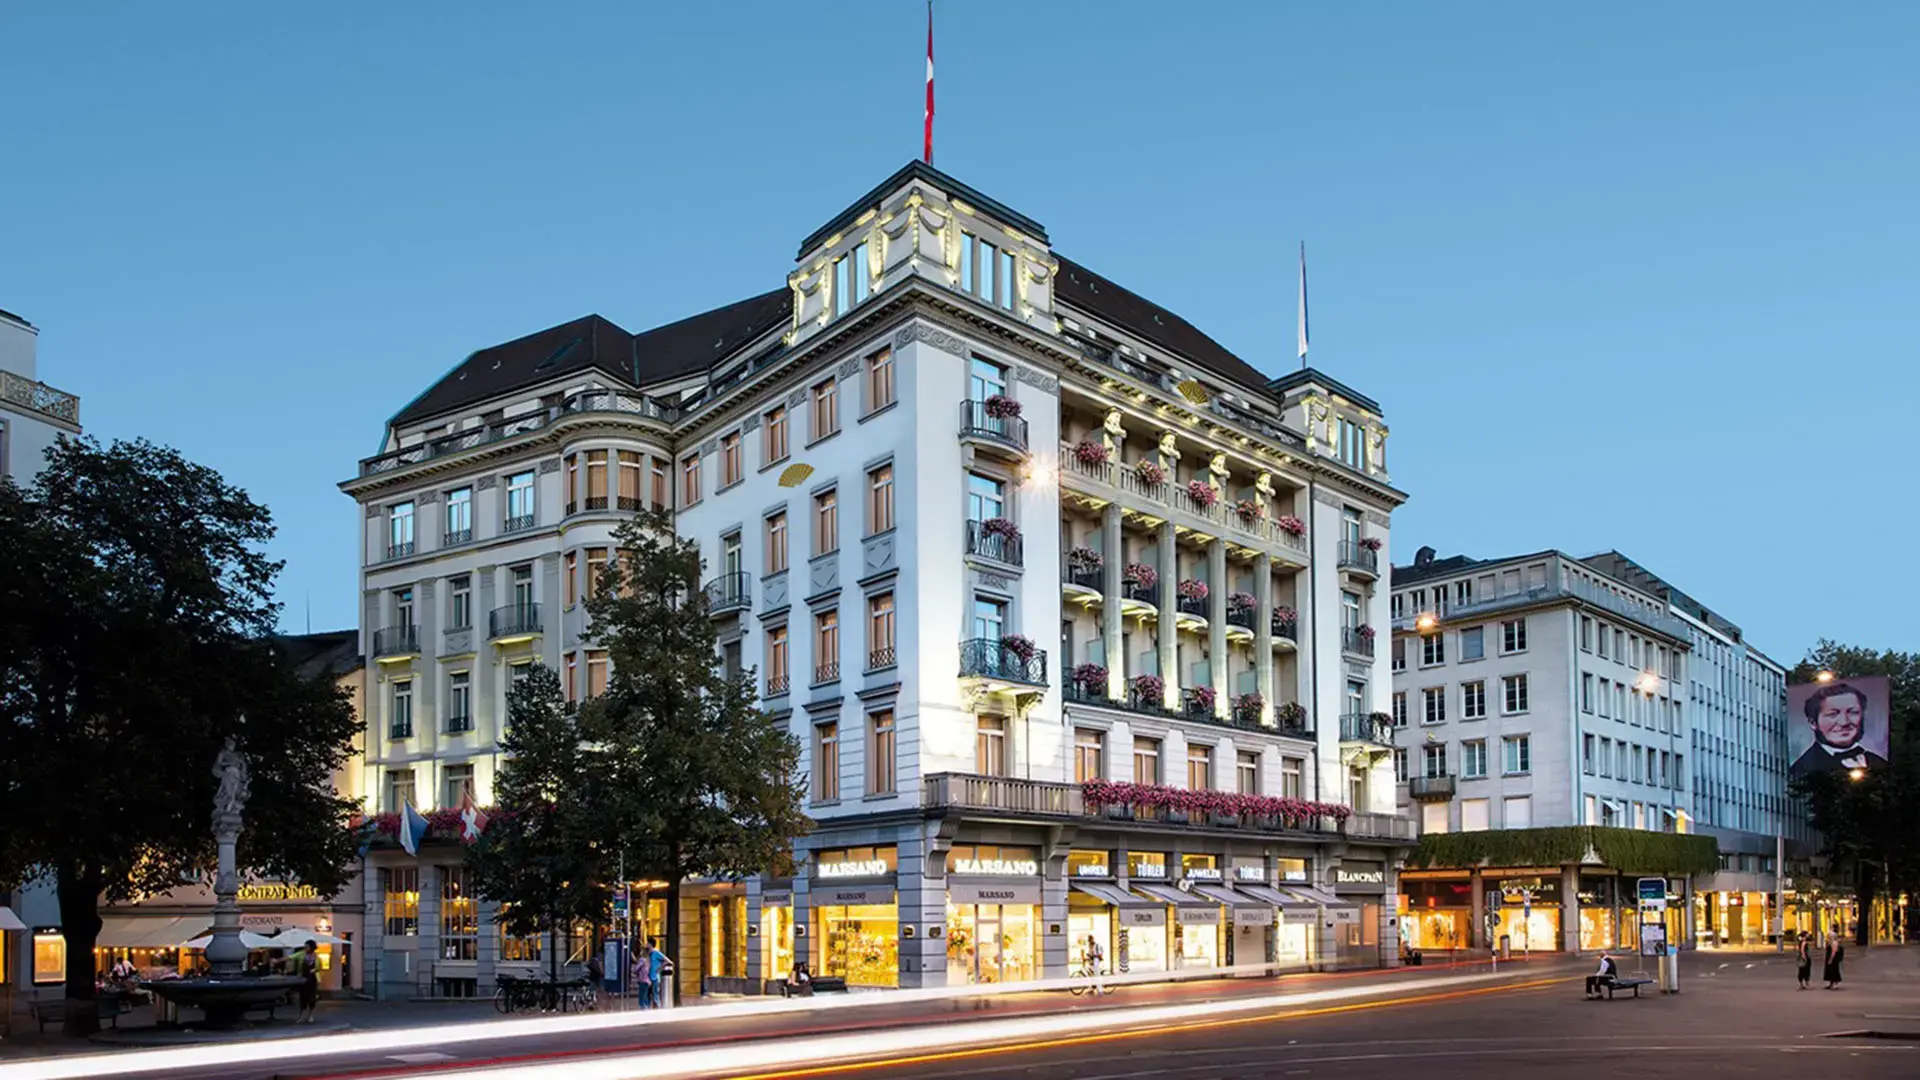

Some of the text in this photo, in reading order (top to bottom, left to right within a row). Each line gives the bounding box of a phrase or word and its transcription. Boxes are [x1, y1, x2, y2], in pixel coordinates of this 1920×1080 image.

[818, 860, 888, 877] MARSANO
[954, 859, 1037, 876] MARSANO
[1137, 863, 1165, 878] TÜRLER
[1337, 870, 1383, 883] BLANCPAIN
[836, 892, 867, 900] MARSANO
[978, 891, 1015, 899] MARSANO
[242, 916, 284, 925] RISTORANTE
